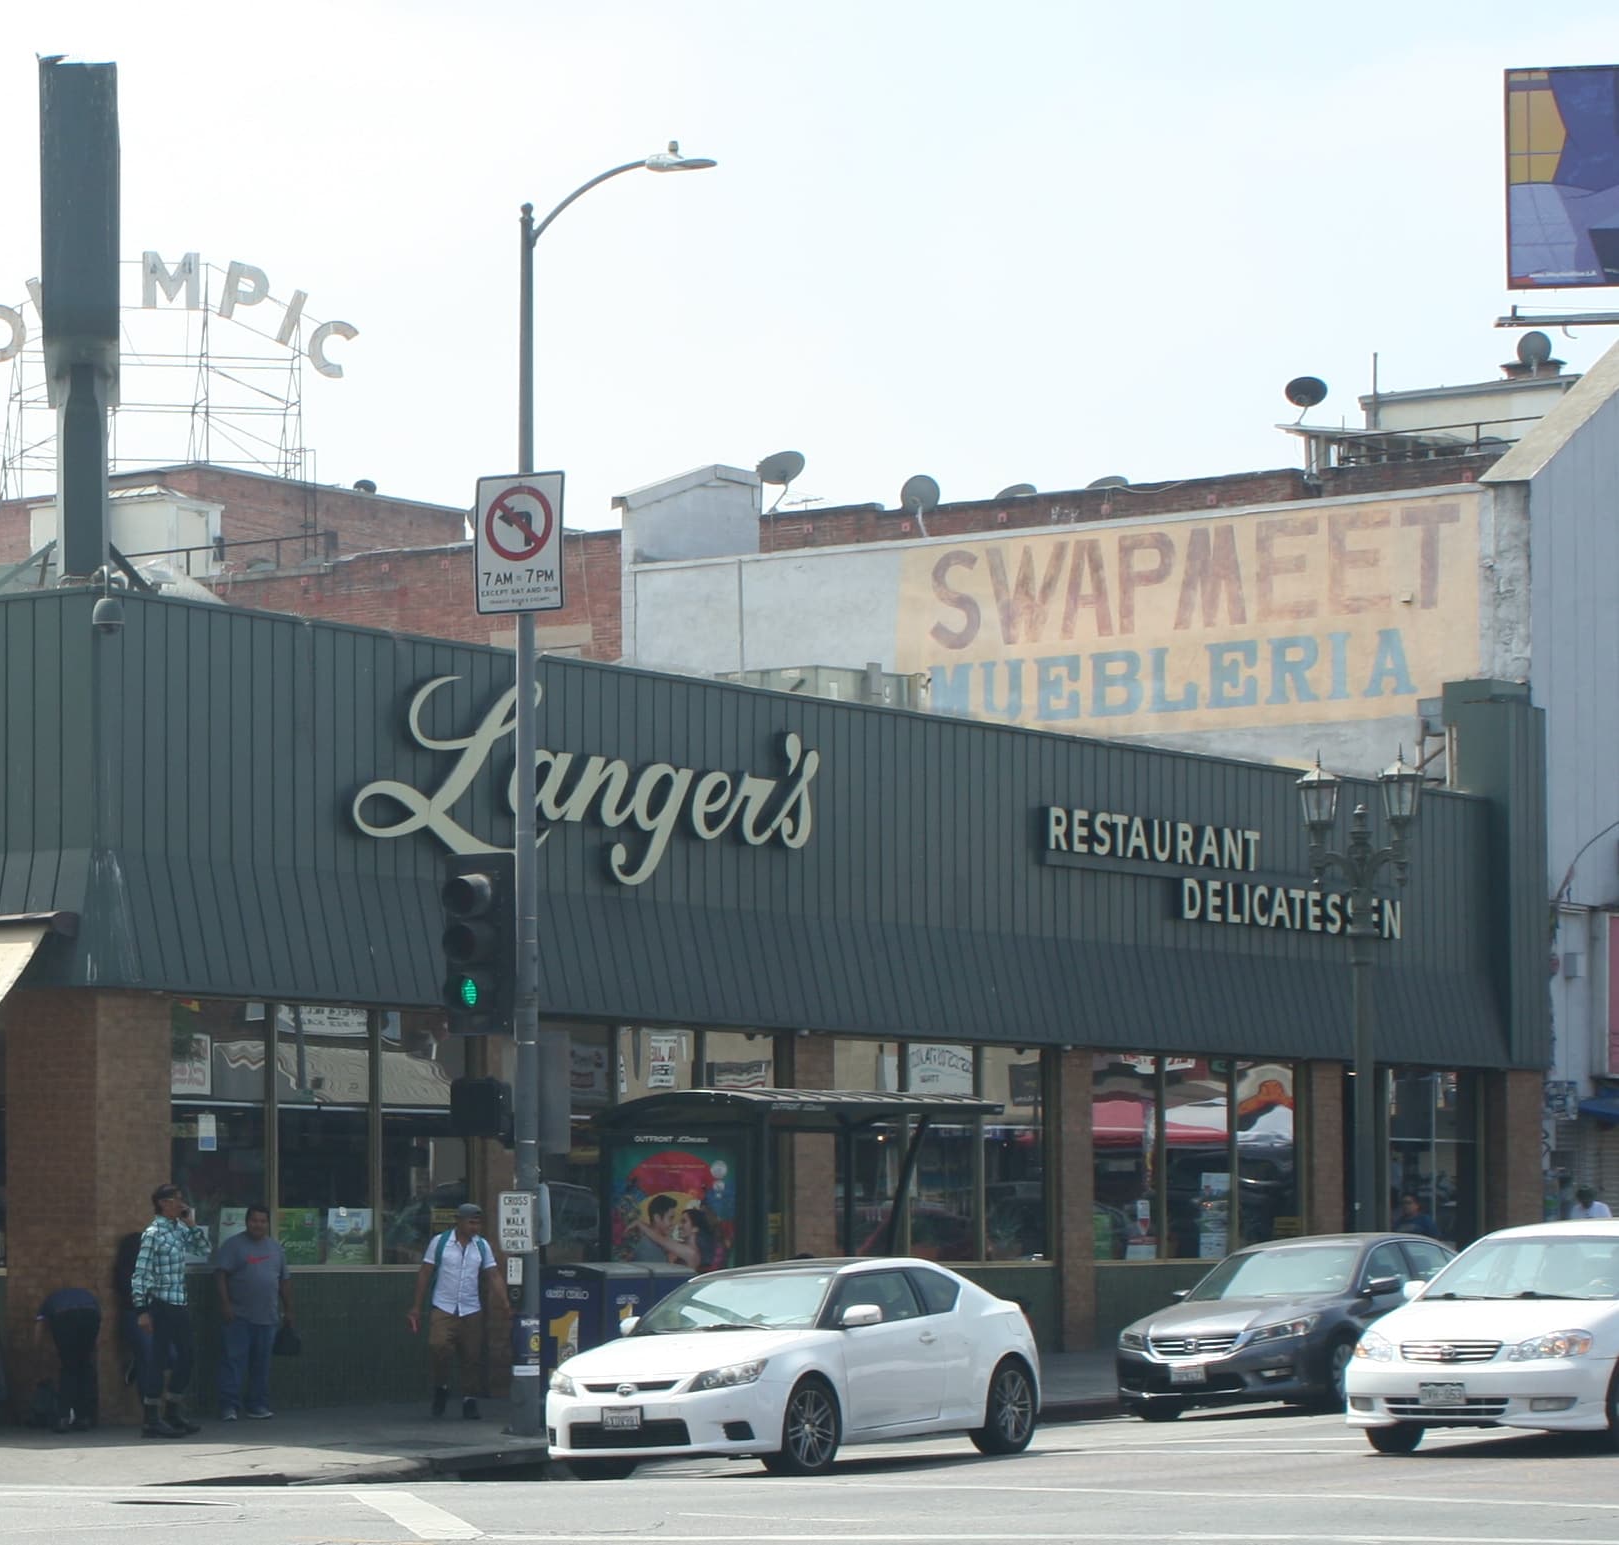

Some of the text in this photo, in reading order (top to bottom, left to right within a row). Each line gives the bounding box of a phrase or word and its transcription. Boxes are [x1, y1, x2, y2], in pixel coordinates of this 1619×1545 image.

[483, 572, 492, 586] 7
[494, 572, 513, 586] AM
[525, 569, 534, 583] 7
[536, 570, 554, 582] PM
[927, 628, 1418, 722] MUEBLERIA
[352, 675, 819, 886] Langer's
[1048, 806, 1261, 872] RESTAURANT
[503, 1195, 529, 1206] CROSS
[506, 1217, 526, 1226] WALK
[502, 1228, 530, 1238] SIGNAL
[506, 1239, 526, 1249] ONLY
